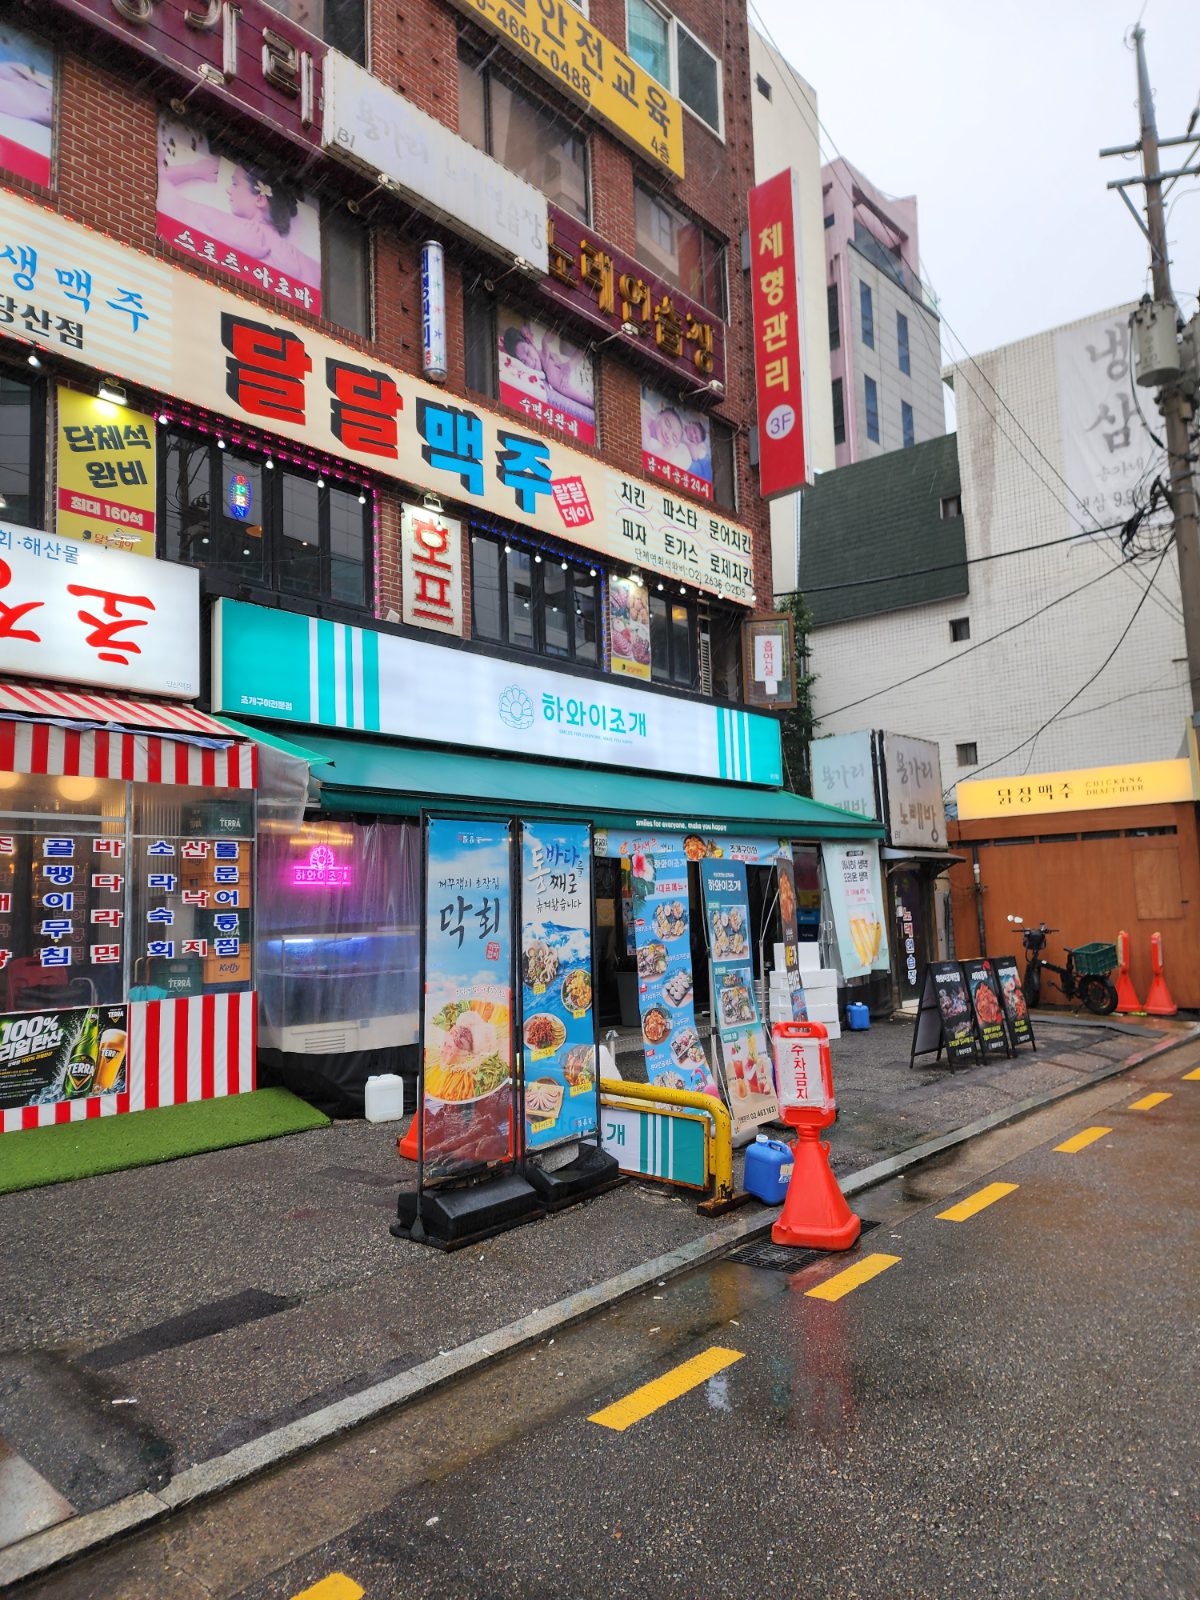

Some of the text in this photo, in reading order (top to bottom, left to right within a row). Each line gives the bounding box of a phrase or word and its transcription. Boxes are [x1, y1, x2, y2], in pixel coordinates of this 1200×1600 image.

[508, 0, 671, 138] 안전교육
[651, 136, 670, 164] 4층
[758, 222, 791, 392] 체형관리
[220, 310, 554, 518] 달달맥주
[519, 396, 580, 437] 수면실완비
[770, 415, 792, 433] 3F
[63, 425, 152, 452] 단체석
[86, 460, 148, 488] 완비
[70, 495, 144, 526] 최대 160석
[621, 481, 752, 555] 치킨 파스타 문어치킨
[411, 516, 455, 627] 호프
[622, 518, 752, 585] 피자 돈가스 로제치킨
[542, 692, 646, 737] 하와이조개
[997, 783, 1075, 805] 닭장맥주
[1119, 784, 1144, 793] BEER
[219, 817, 241, 829] TERRA
[900, 802, 938, 842] 노래방
[41, 838, 75, 966] 골뱅이무침
[91, 838, 126, 964] 바다라면
[147, 839, 177, 958] 소라숙회
[182, 841, 209, 957] 산낙지
[214, 841, 240, 957] 돌문어통찜
[708, 879, 741, 891] 하와이조개
[440, 895, 501, 950] 막회
[168, 978, 191, 989] TERRA
[219, 963, 240, 974] Kelly
[0, 1030, 63, 1062] 리얼탄산
[2, 1014, 60, 1044] 100%
[67, 1062, 95, 1075] TERRA
[790, 1043, 809, 1099] 주차금지
